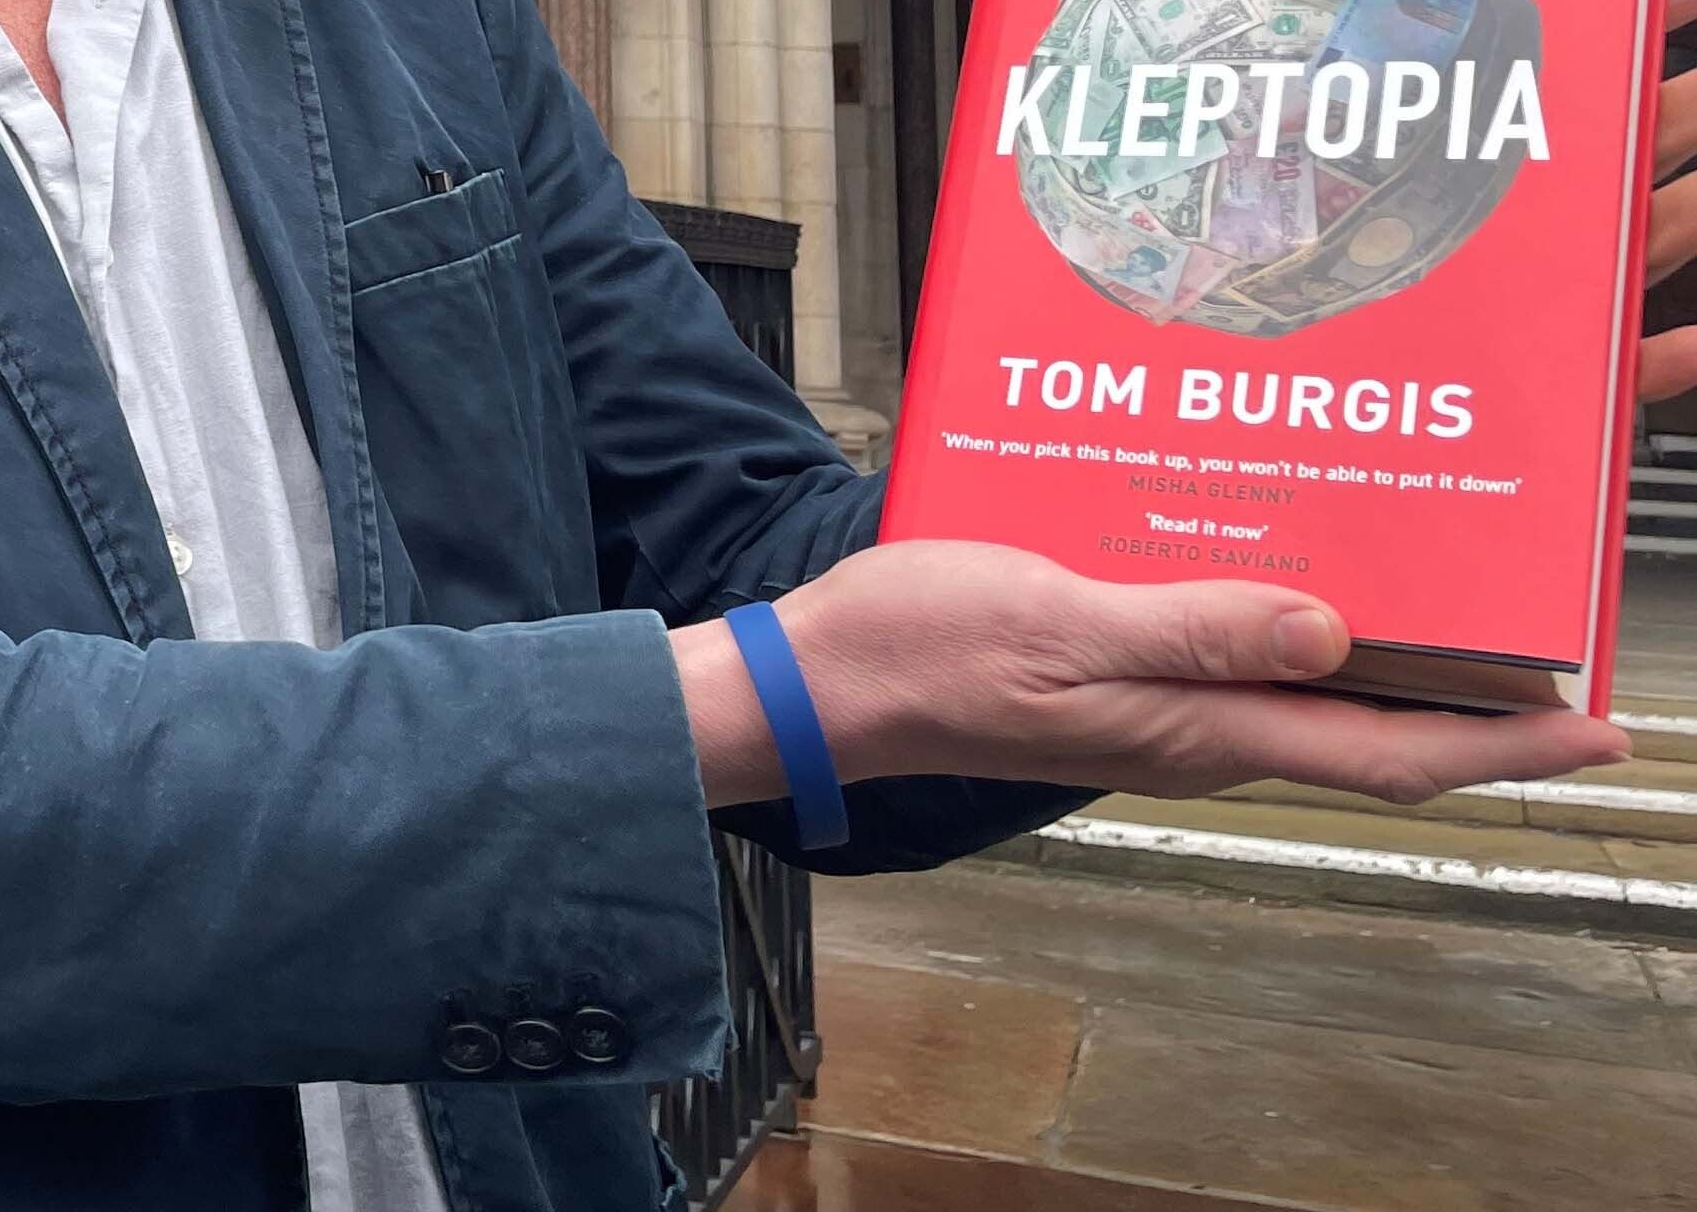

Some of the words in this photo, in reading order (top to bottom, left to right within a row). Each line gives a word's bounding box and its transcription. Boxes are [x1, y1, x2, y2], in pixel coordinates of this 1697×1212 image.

[997, 59, 1549, 161] KLEPTOPIA
[999, 357, 1146, 416] TOM
[1177, 369, 1473, 438] BURGIS
[942, 432, 994, 451] 'When
[999, 440, 1030, 456] you
[1035, 441, 1071, 459] pick
[1077, 445, 1110, 462] this
[1116, 448, 1159, 466] book
[1165, 455, 1193, 472] up,
[1199, 457, 1233, 474] you
[1239, 460, 1291, 478] won't
[1297, 462, 1320, 480] be
[1326, 465, 1368, 484] able
[1374, 470, 1394, 485] to
[1399, 473, 1433, 490] put
[1439, 472, 1453, 490] it
[1459, 475, 1523, 495] down'
[1128, 475, 1199, 496] MISHA
[1206, 483, 1296, 504] GLENNY
[1145, 512, 1198, 535] 'Read
[1203, 519, 1216, 536] it
[1222, 525, 1269, 541] now'
[1099, 537, 1200, 561] ROBERTO
[1210, 548, 1310, 573] SAVIANO
